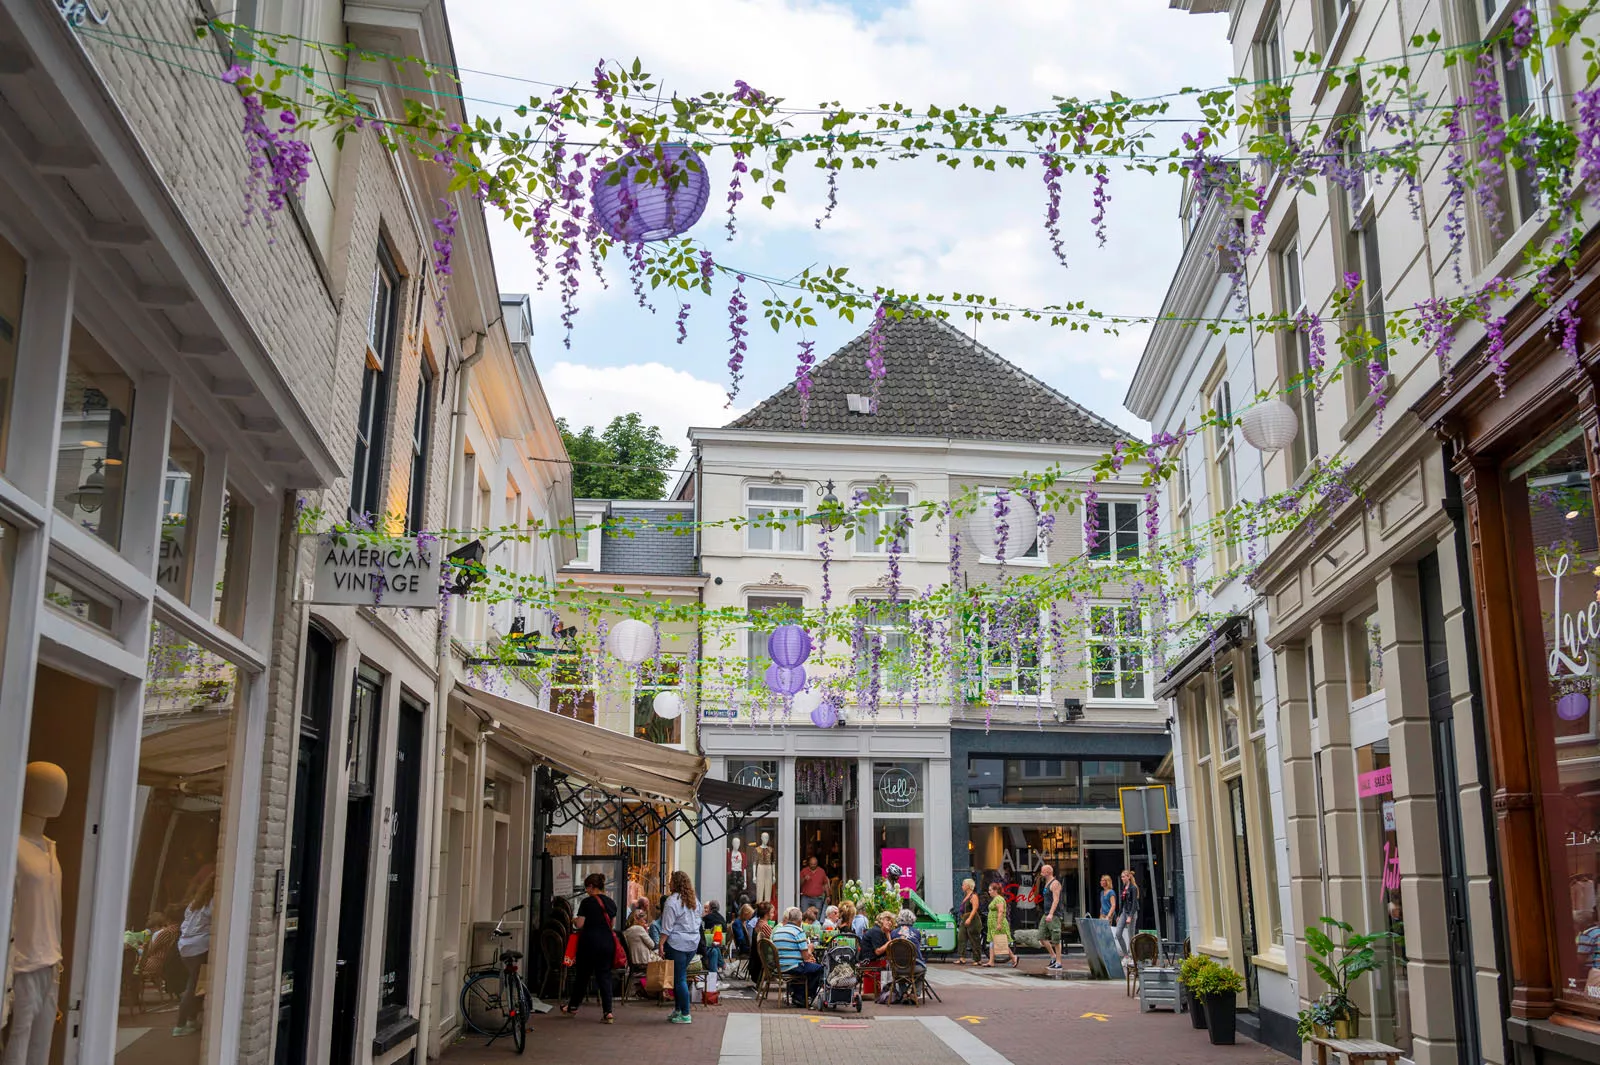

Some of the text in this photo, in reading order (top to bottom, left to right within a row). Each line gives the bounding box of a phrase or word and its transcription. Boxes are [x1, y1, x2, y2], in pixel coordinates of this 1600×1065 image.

[324, 549, 432, 569] AMERICAN
[333, 571, 420, 593] VINTAGE
[881, 777, 916, 798] Hello
[606, 833, 647, 848] SALE
[1003, 883, 1044, 904] Sale
